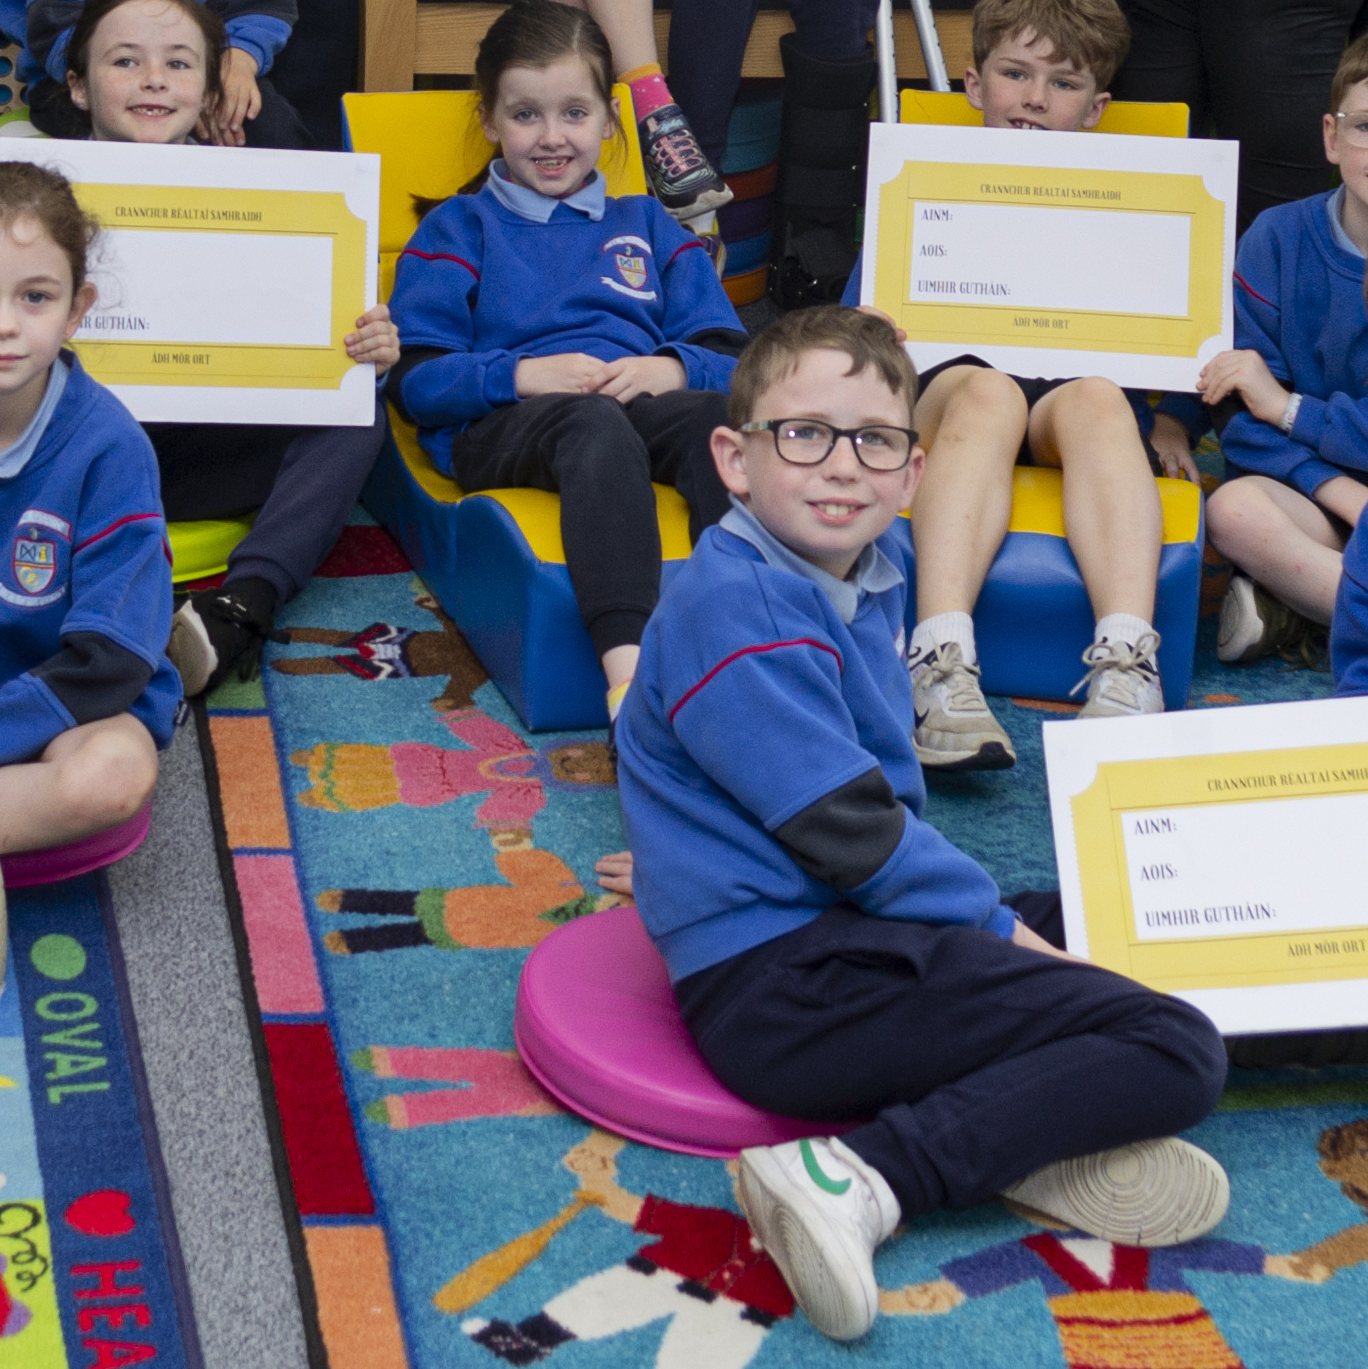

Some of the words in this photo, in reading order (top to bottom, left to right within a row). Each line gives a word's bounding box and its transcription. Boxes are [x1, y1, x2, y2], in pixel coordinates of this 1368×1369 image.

[980, 183, 1031, 197] CRANNCHUR
[1071, 188, 1122, 201] SAMHRAIDH
[115, 206, 169, 219] CRANNCHUR
[210, 210, 263, 222] SAMHRAIDH
[921, 208, 953, 222] AINM:
[919, 244, 948, 257] AOIS:
[917, 280, 957, 294] UIMHIR
[959, 280, 1012, 296] GUTHÁIN:
[95, 314, 150, 331] GUTHÁIN:
[1051, 318, 1069, 329] ORT
[192, 354, 210, 365] ORT
[1207, 772, 1280, 792] CRANNCHUR
[1280, 769, 1330, 789] RÉALTAÍ
[1134, 816, 1177, 837] AINM:
[1140, 863, 1179, 882] AOIS:
[1145, 908, 1201, 928] UIMHIR
[1203, 901, 1277, 925] GUTHÁIN:
[1287, 940, 1313, 957] ÁDH
[1314, 938, 1340, 956] MÓR
[1342, 939, 1367, 955] ORT
[33, 991, 111, 1107] OVAL
